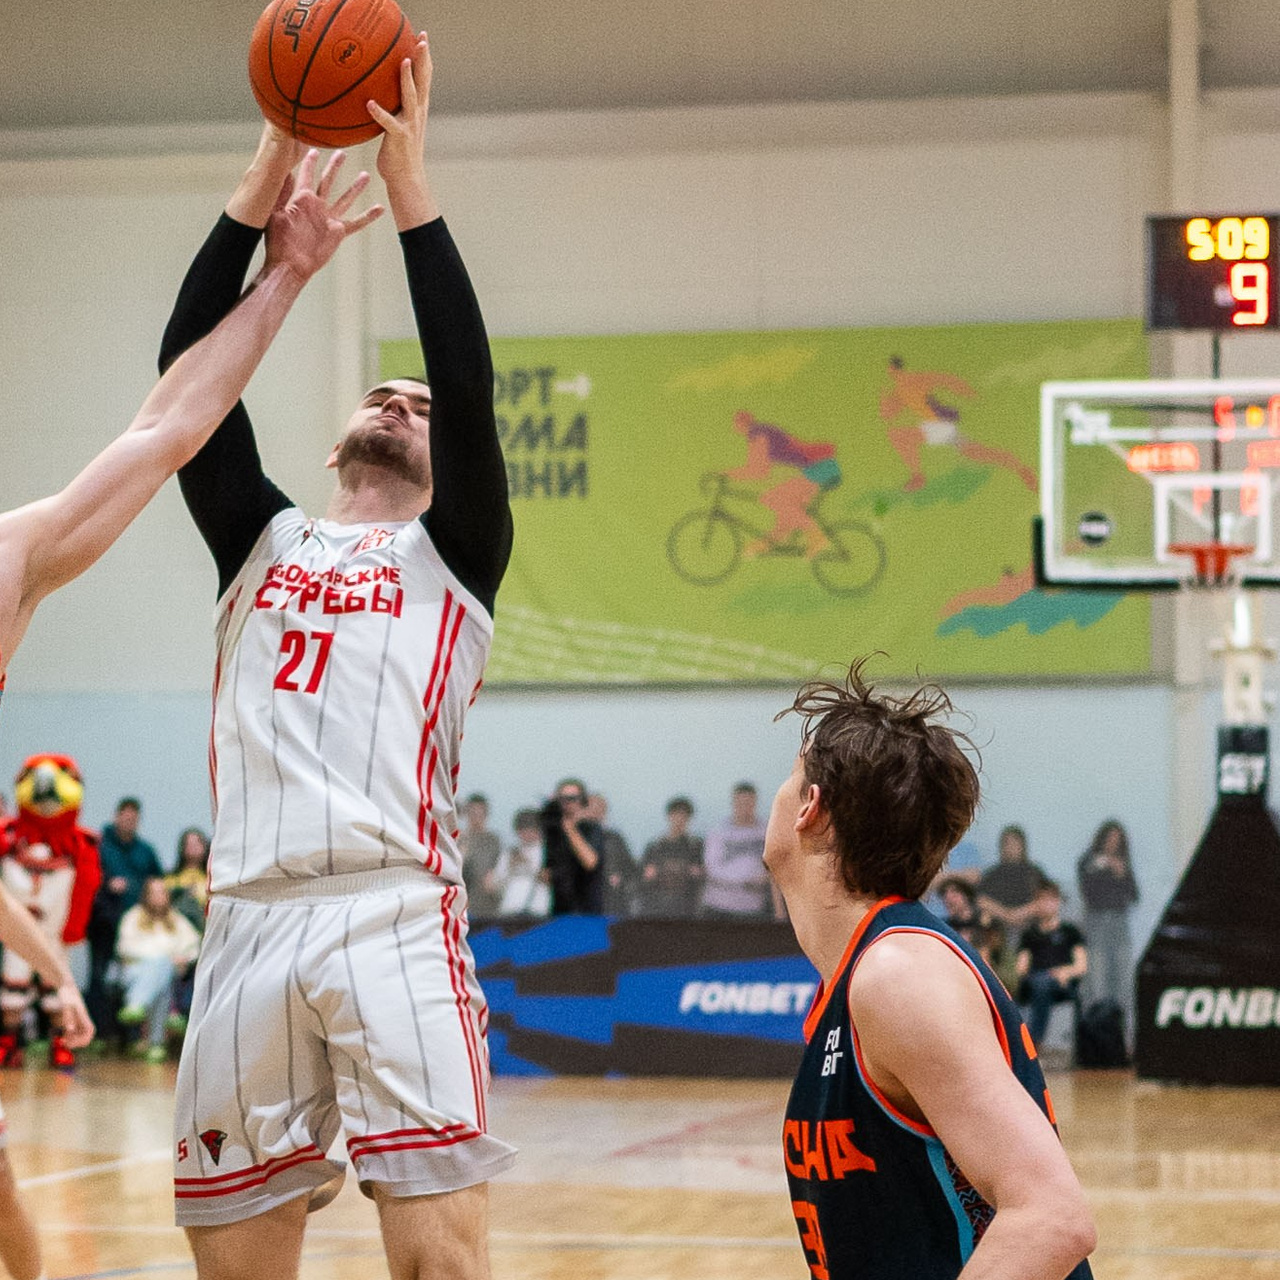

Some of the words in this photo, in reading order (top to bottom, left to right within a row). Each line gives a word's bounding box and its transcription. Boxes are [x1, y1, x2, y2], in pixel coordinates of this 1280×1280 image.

[1230, 261, 1269, 326] 9
[254, 580, 404, 619] СТРЕБЫ
[274, 630, 334, 694] 27
[679, 981, 817, 1014] FONBET
[1156, 987, 1280, 1028] FONB
[783, 1119, 877, 1181] СНА
